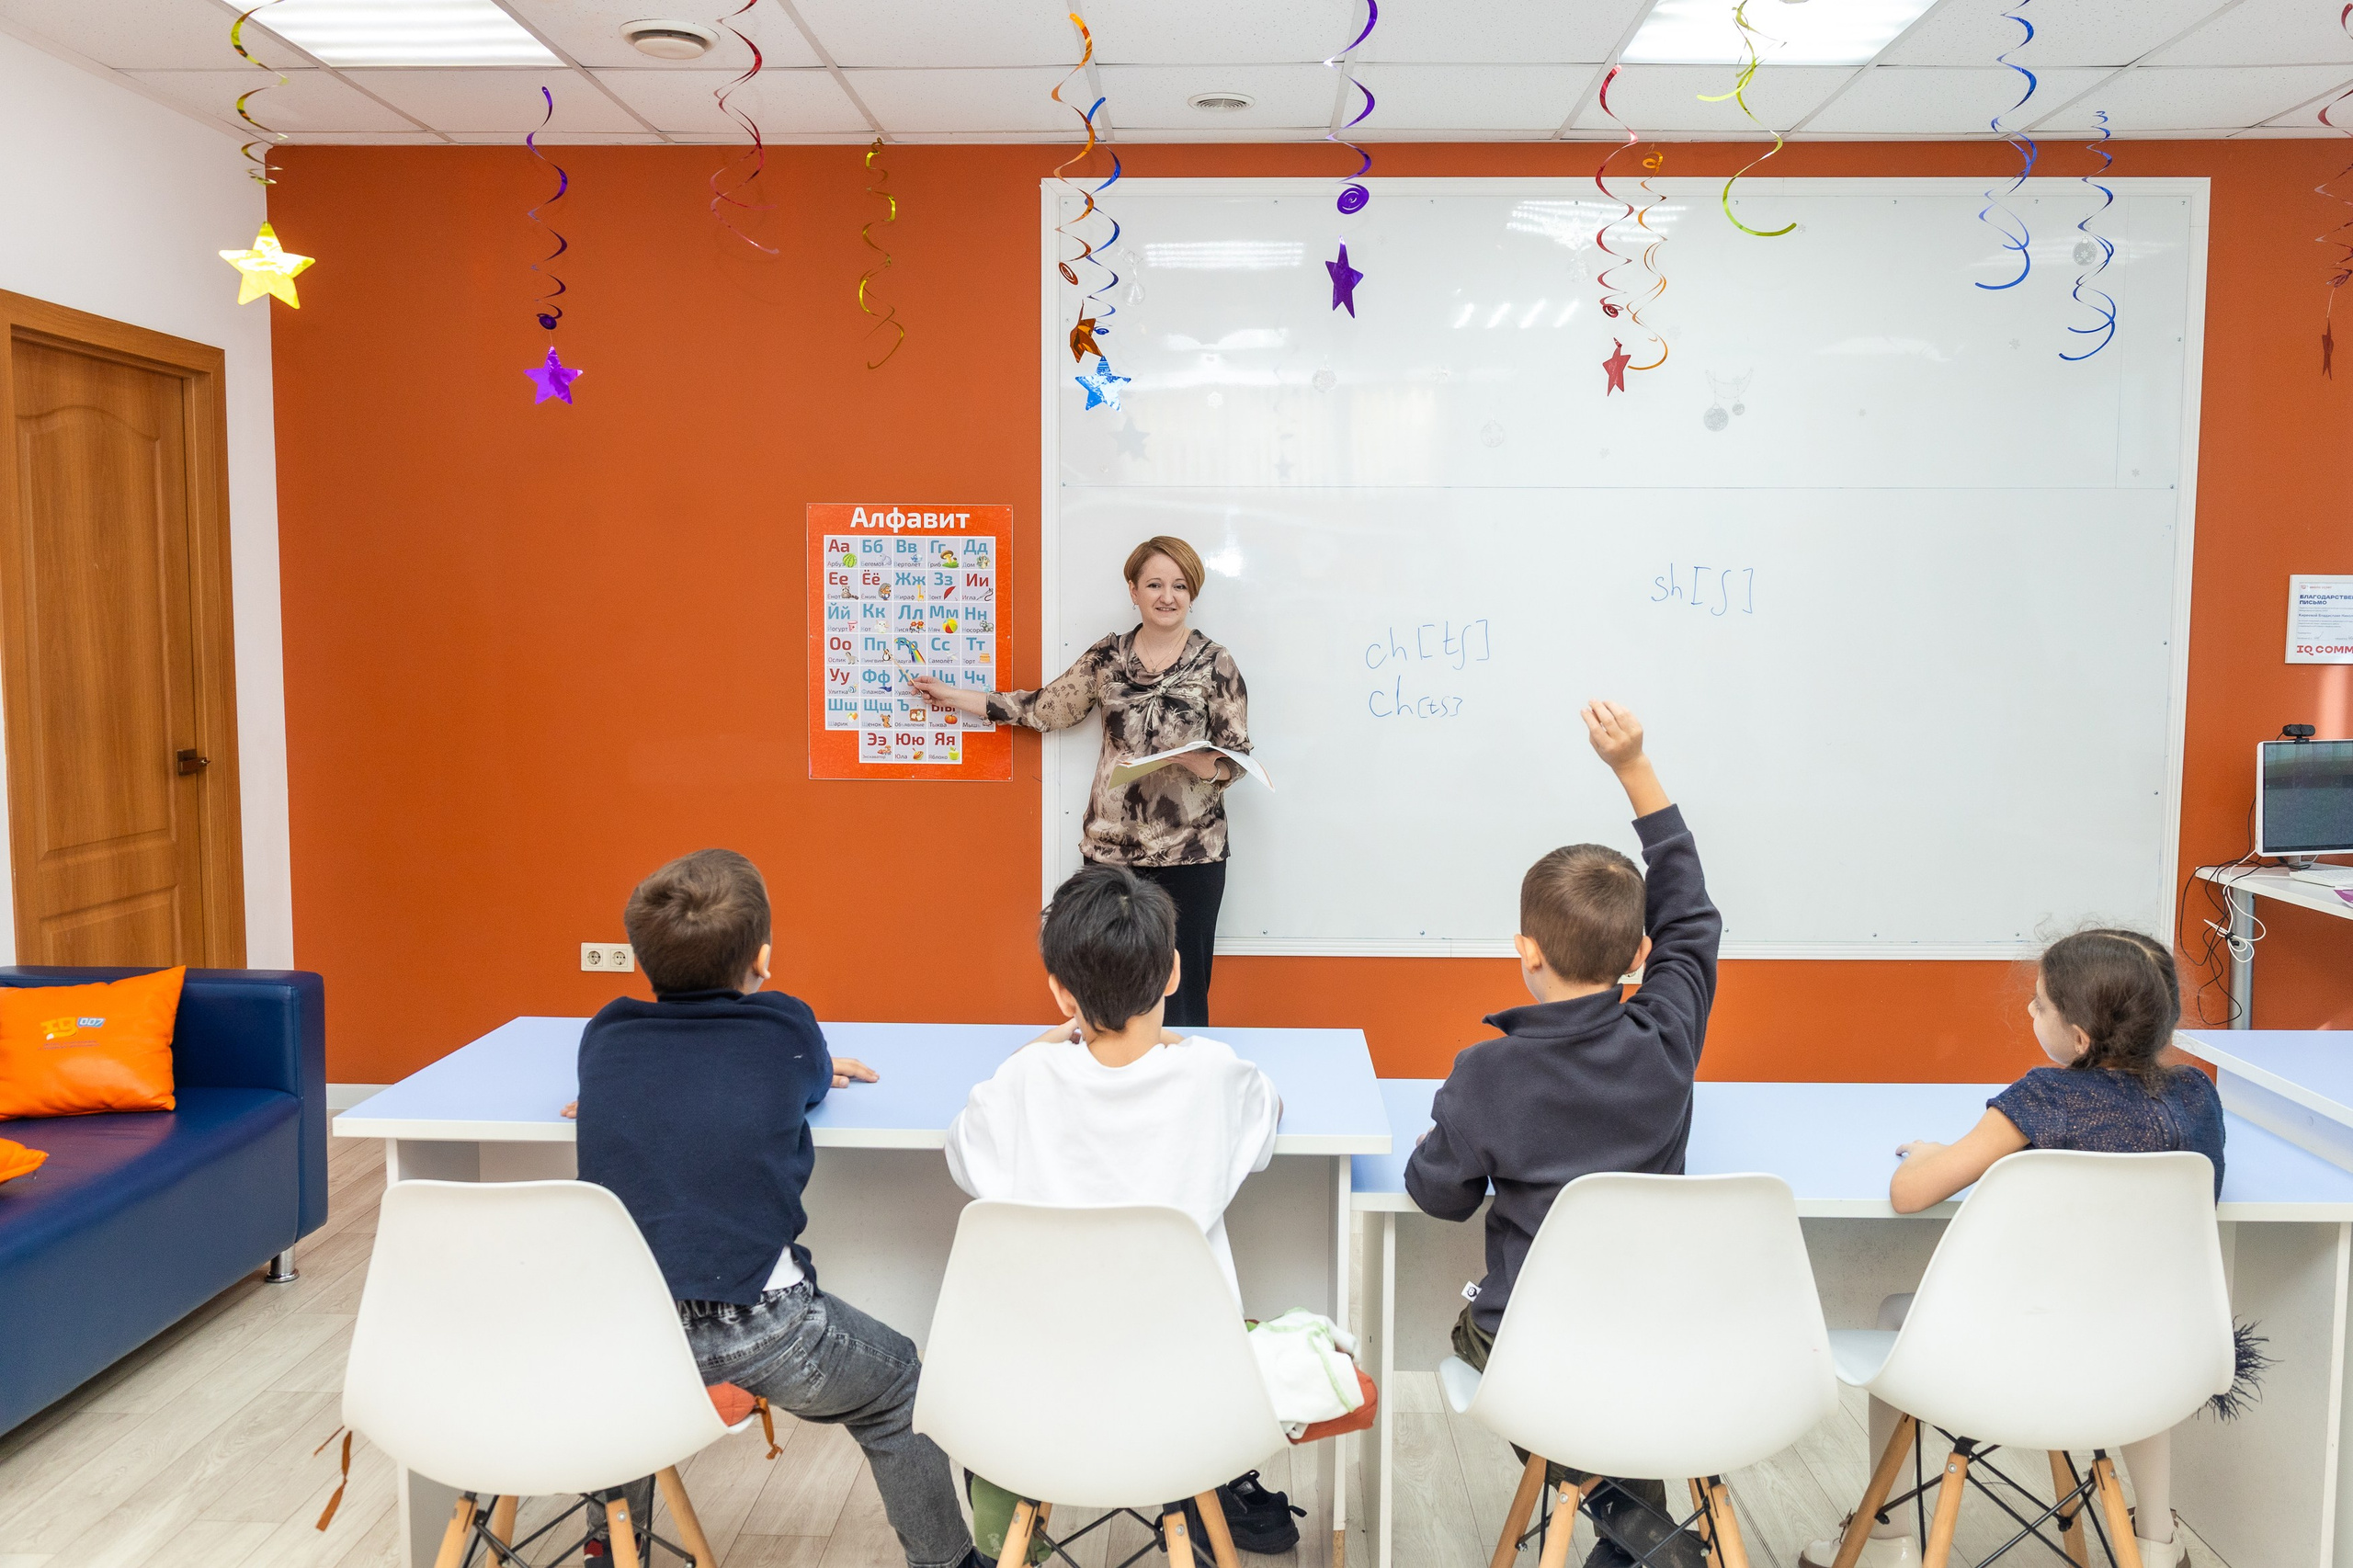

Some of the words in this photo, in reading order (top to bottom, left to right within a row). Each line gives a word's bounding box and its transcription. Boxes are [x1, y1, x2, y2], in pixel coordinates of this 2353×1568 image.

[850, 506, 971, 533] Алфавит
[828, 539, 850, 553] Аа
[862, 539, 883, 553] Бб
[896, 539, 917, 553] Вв
[930, 540, 946, 553] Гг
[963, 539, 988, 555] Дд
[829, 572, 848, 585] Ее
[862, 569, 881, 585] Ёё
[894, 572, 926, 585] Жж
[934, 572, 953, 585] Зз
[966, 573, 989, 587] Ии
[828, 602, 850, 619] Йй
[863, 603, 886, 619] Кк
[897, 604, 923, 620] Лл
[929, 605, 959, 619] Мм
[964, 607, 987, 620] Нн
[830, 636, 852, 651] Оо
[865, 637, 886, 651] Пп
[896, 636, 918, 653] Рр
[931, 637, 950, 651] Сс
[966, 637, 985, 651] Тт
[2297, 645, 2314, 656] IQ
[2315, 645, 2353, 653] COMM
[829, 667, 850, 686] Уу
[862, 668, 891, 687] Фф
[964, 670, 985, 684] Чч
[828, 699, 858, 710] Шш
[863, 699, 893, 713] Щщ
[897, 699, 910, 711] Ъ
[867, 733, 887, 745] Ээ
[895, 733, 925, 745] Юю
[934, 733, 956, 745] Яя
[79, 1017, 105, 1027] 007
